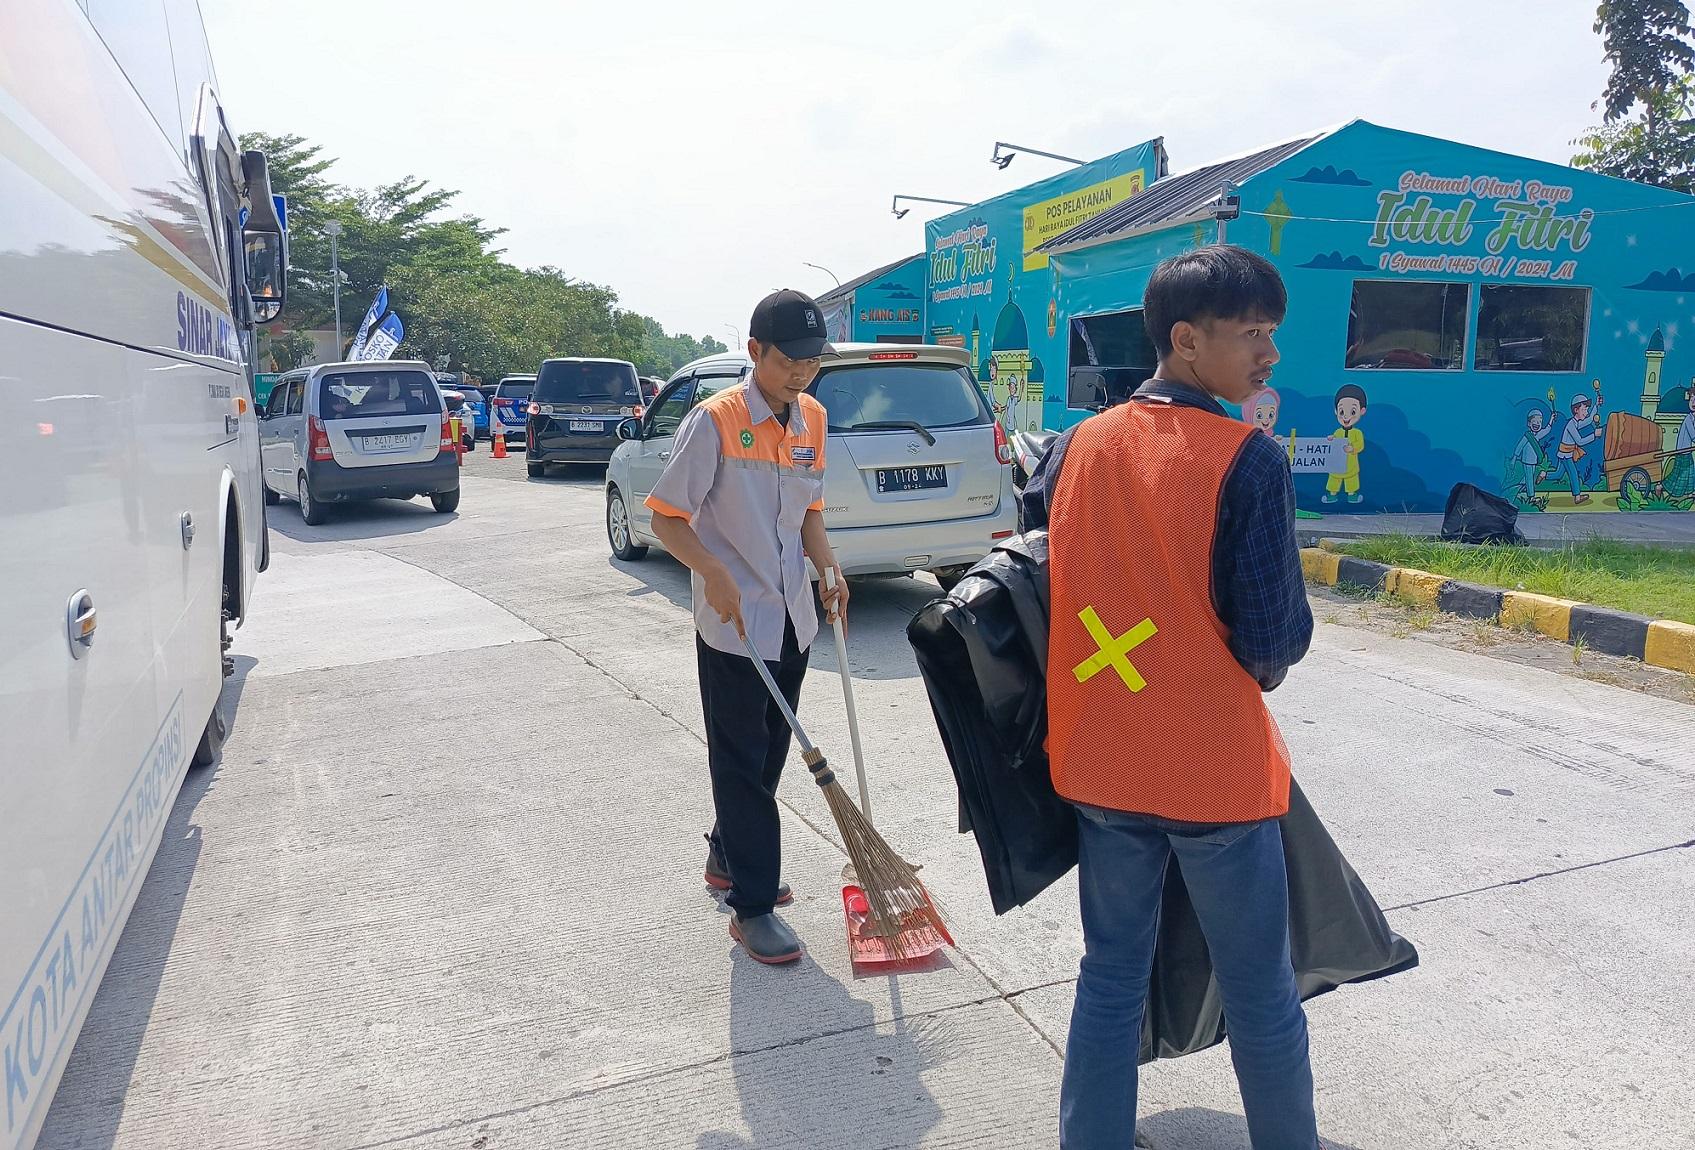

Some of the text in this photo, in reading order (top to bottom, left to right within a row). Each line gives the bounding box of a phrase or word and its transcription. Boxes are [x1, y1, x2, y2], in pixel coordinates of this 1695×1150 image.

[1399, 171, 1572, 203] Selamat Hari Raya
[1046, 204, 1061, 220] POS
[1063, 187, 1112, 215] PELAYANAN
[1039, 224, 1049, 234] HARI
[1051, 220, 1063, 231] RAYA
[1064, 217, 1075, 228] IDUL
[1369, 192, 1594, 253] Idul Fitri
[929, 237, 996, 288] Idul Fitri
[1380, 254, 1388, 268] 1
[1390, 252, 1444, 273] Syawal
[1447, 255, 1479, 273] 1445
[1516, 261, 1550, 276] 2024
[1551, 261, 1576, 279] M
[177, 290, 213, 356] SINAR
[364, 334, 385, 361] OSKO
[364, 434, 408, 446] B 2417 EGY
[1306, 445, 1331, 454] HATI
[1292, 457, 1325, 466] JALAN
[879, 466, 944, 485] B 1178 KKY
[4, 711, 182, 1134] KOTA ANTAR PROPINSI
